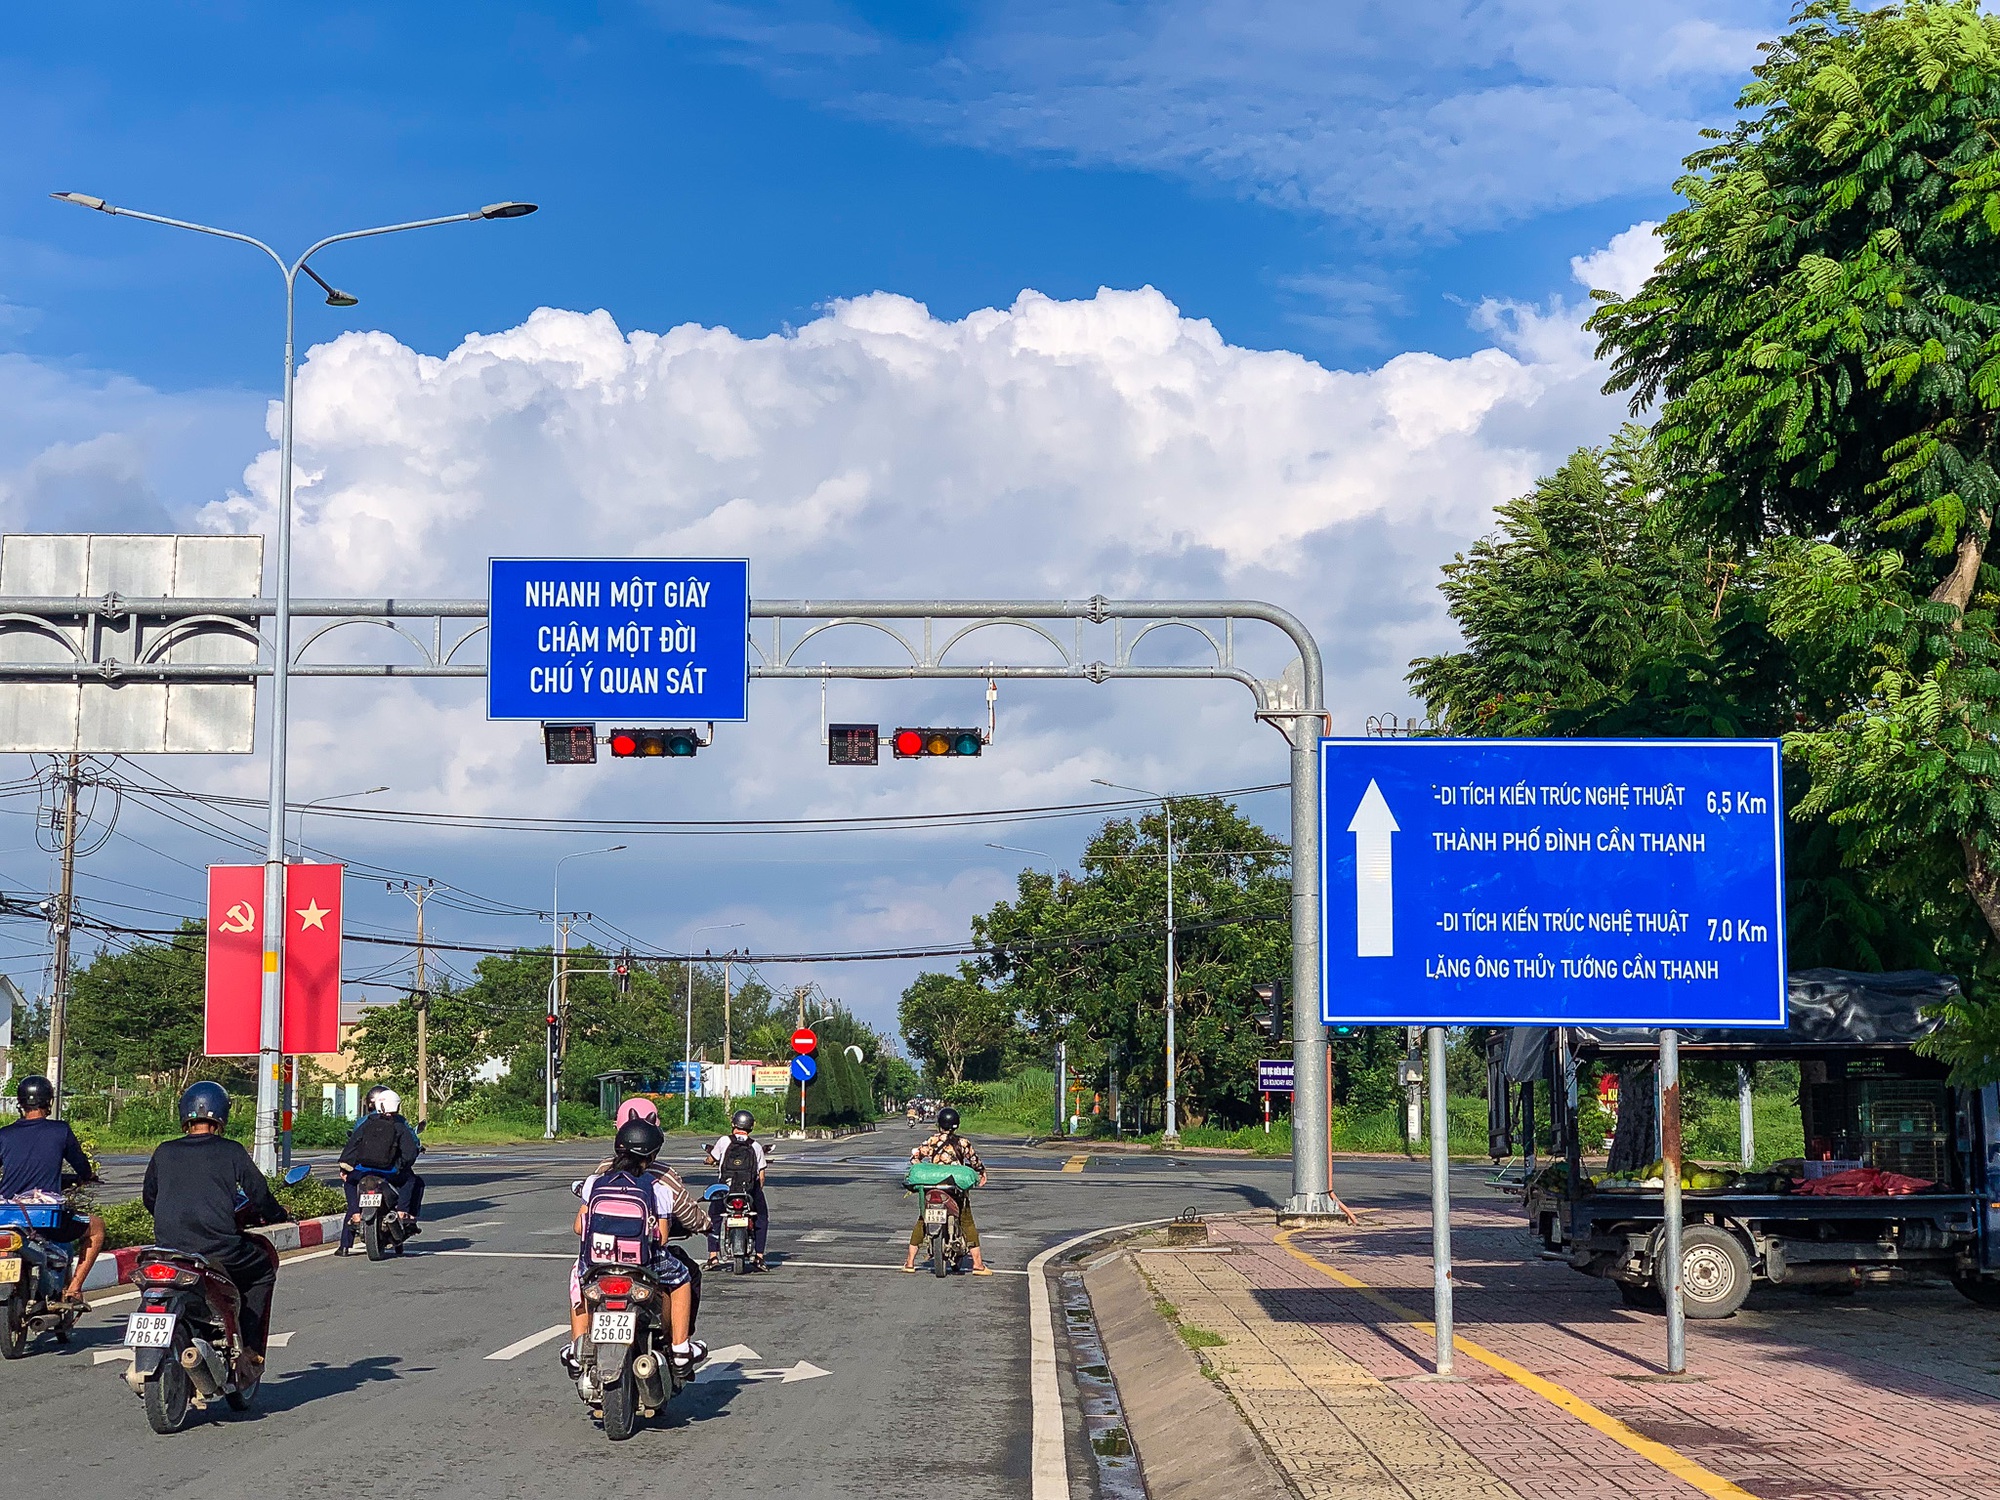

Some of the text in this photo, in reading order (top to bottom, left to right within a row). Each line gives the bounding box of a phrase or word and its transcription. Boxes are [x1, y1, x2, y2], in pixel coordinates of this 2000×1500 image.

[525, 576, 711, 612] NHANH MỘT GIÂY
[538, 620, 696, 658] CHẬM MỘT ĐỜI
[530, 661, 708, 694] CHÚ Ý QUAN SÁT
[1434, 780, 1767, 815] -DI TÍCH KIẾN TRÚC NGHỆ THUẬT 6,5 Km
[1432, 826, 1705, 857] THÀNH PHỐ ĐÌNH CẦN THẠNH
[1436, 906, 1768, 943] -DI TÍCH KIẾN TRÚC NGHỆ THUẬT 7,0 Km
[1426, 953, 1719, 984] LĂNG ÔNG THỦY TƯỚNG CẦN THẠNH
[136, 1317, 167, 1330] 60-B9
[594, 1328, 631, 1340] 256.09
[599, 1315, 629, 1326] 59-Z2
[128, 1330, 169, 1344] 786.47
